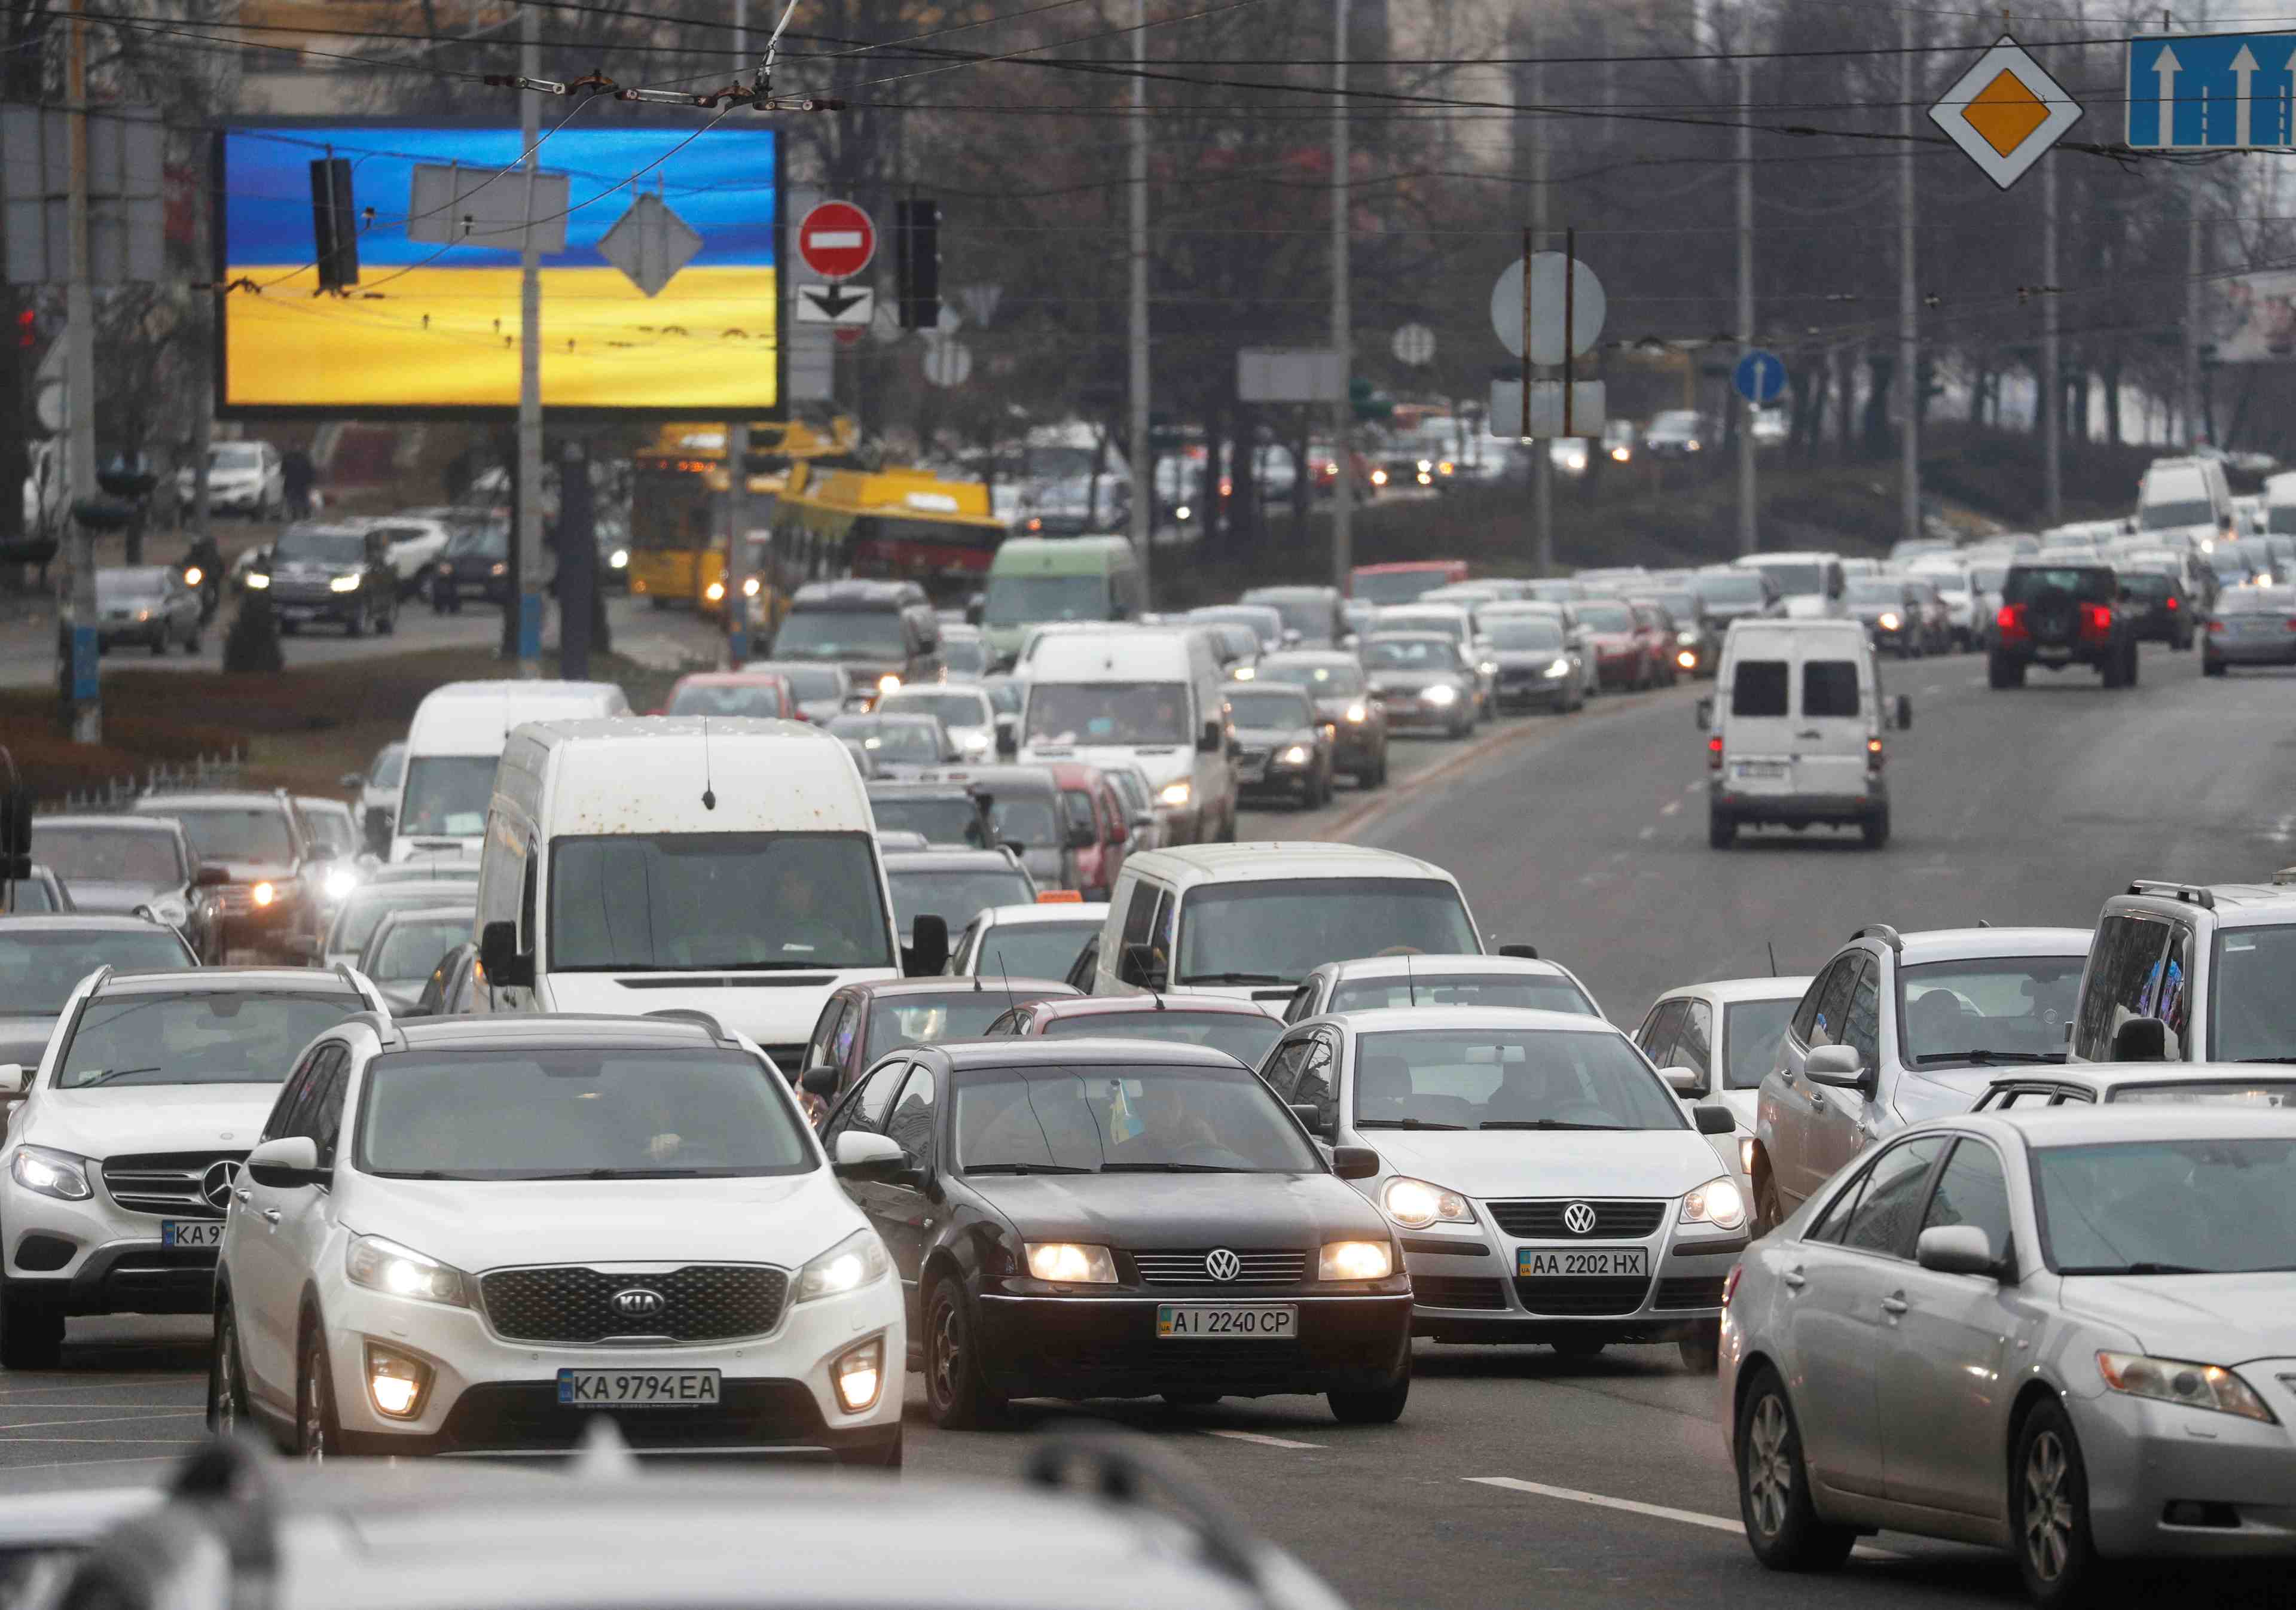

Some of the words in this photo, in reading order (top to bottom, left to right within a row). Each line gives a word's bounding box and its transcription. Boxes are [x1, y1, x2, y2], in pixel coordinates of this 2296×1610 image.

[1565, 1203, 1595, 1233] VW
[176, 1226, 204, 1244] KA
[209, 1225, 225, 1244] 9
[1207, 1249, 1239, 1280] VW
[1533, 1255, 1559, 1274] AA
[1565, 1255, 1608, 1274] 2202
[1614, 1255, 1640, 1274] HX
[620, 1295, 656, 1311] KIA
[1208, 1312, 1256, 1332] 2240
[1260, 1312, 1290, 1332] CP
[575, 1376, 610, 1399] KA
